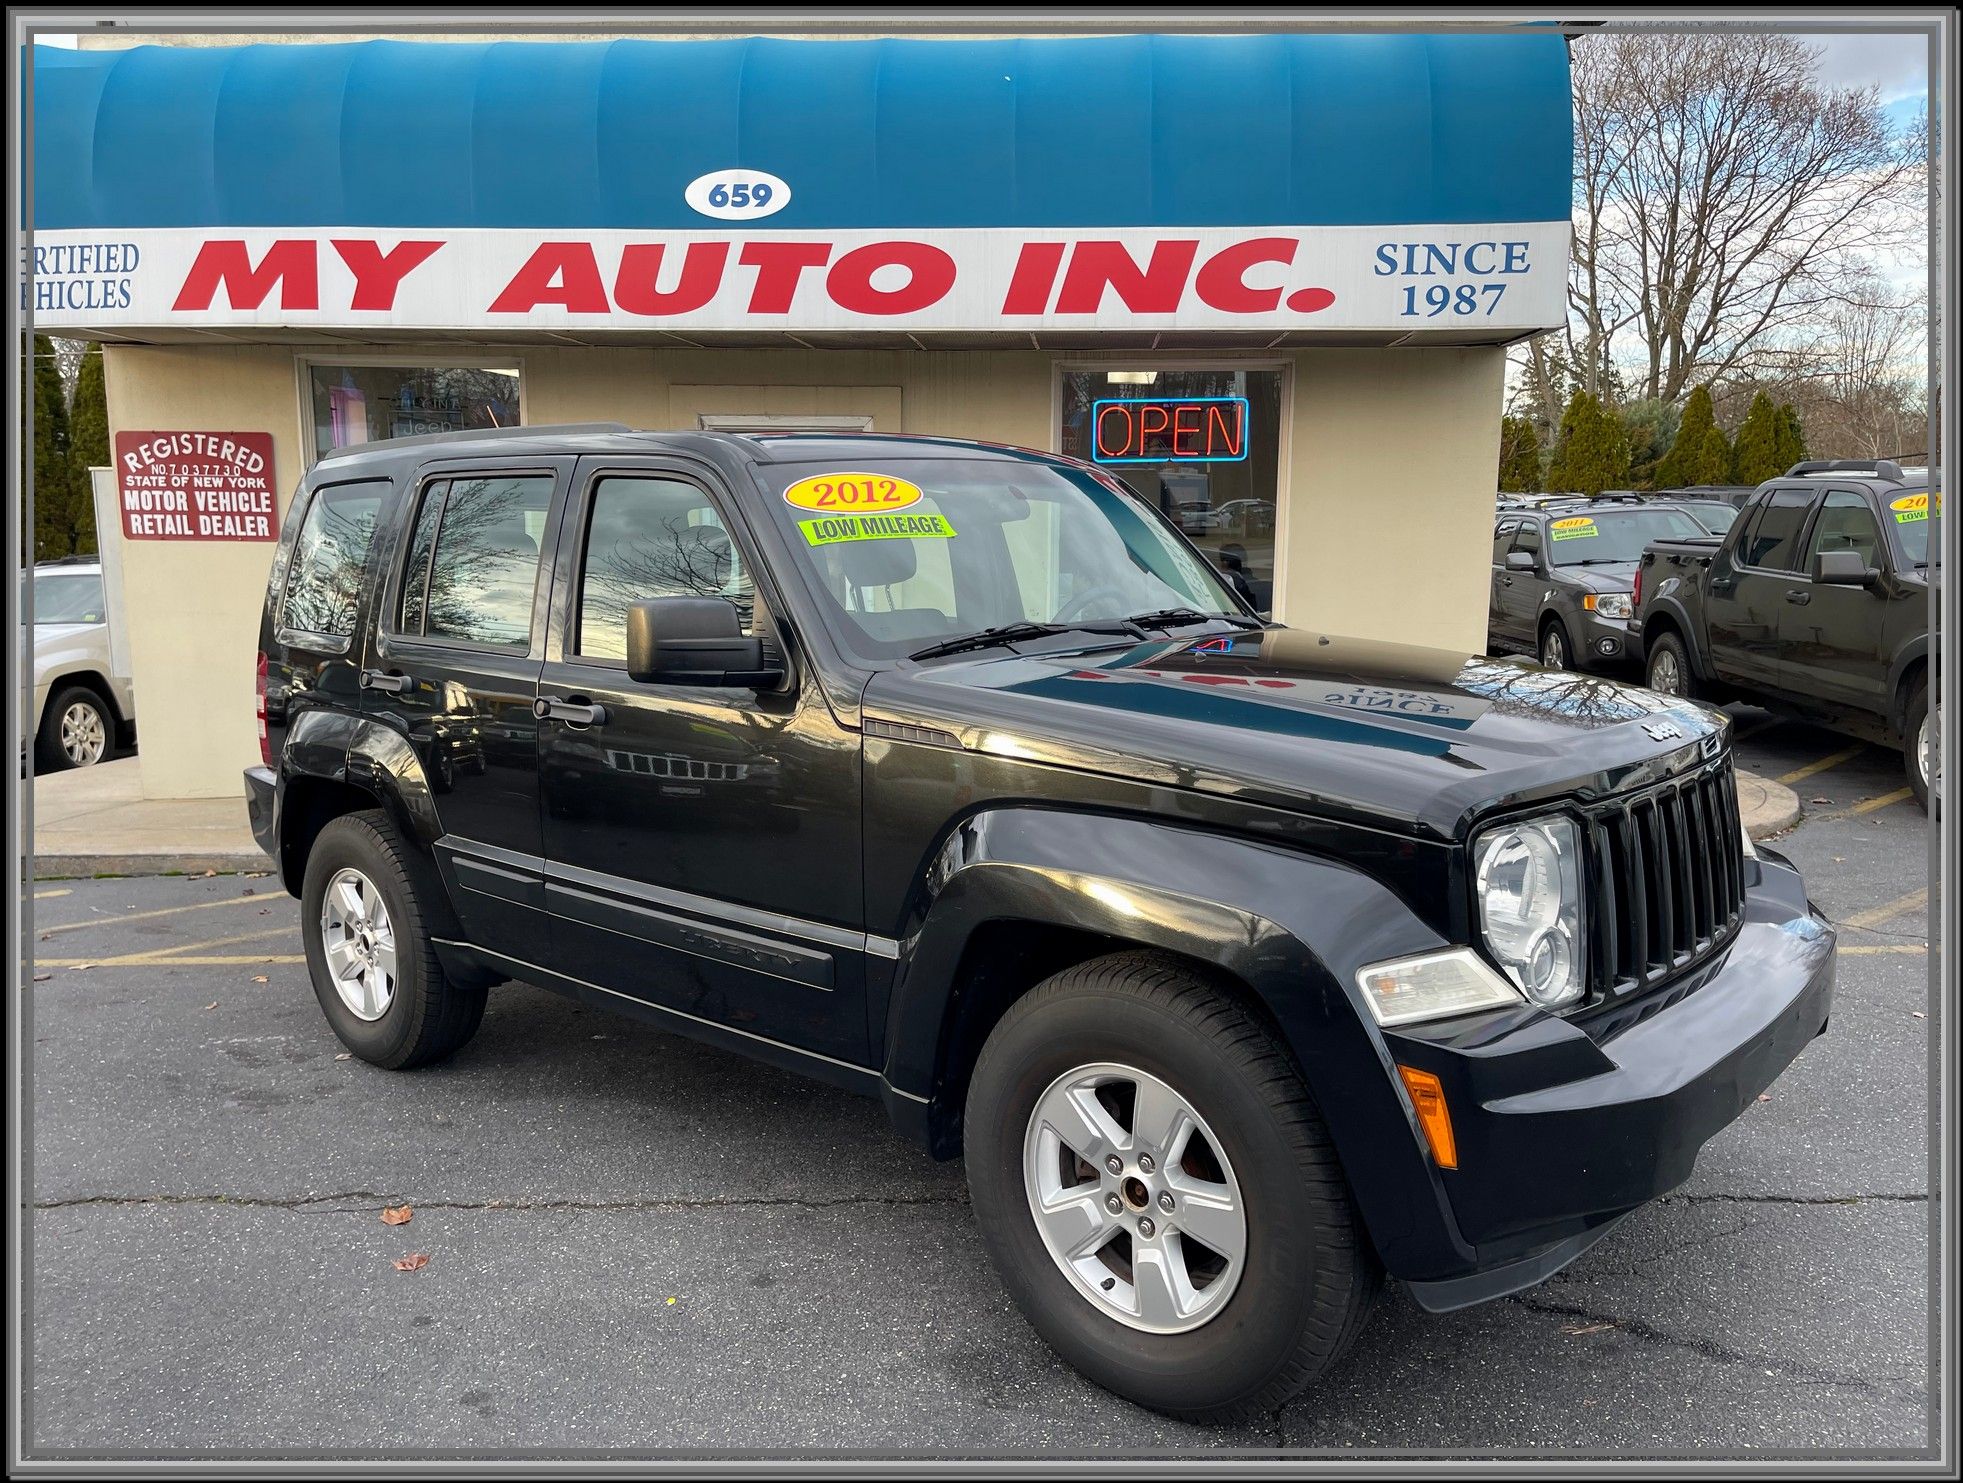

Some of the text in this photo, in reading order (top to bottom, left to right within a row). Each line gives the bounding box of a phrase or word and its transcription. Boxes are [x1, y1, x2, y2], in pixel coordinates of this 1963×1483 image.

[708, 183, 773, 208] 659
[1374, 242, 1531, 276] SINCE
[171, 237, 1336, 316] MY AUTO INC.
[1400, 283, 1507, 317] 1987
[1097, 404, 1242, 456] OPEN
[124, 433, 264, 474] REGISTERED
[126, 475, 266, 489] STATE OF NEW YORK
[813, 480, 900, 507] 2012
[124, 490, 272, 513] MOTOR VEHICLE
[130, 514, 270, 537] RETAIL DEALER
[1560, 519, 1584, 528] 2011
[1902, 511, 1925, 520] LOW
[812, 516, 945, 540] LOW MILEAGE
[1640, 721, 1682, 742] Jeep
